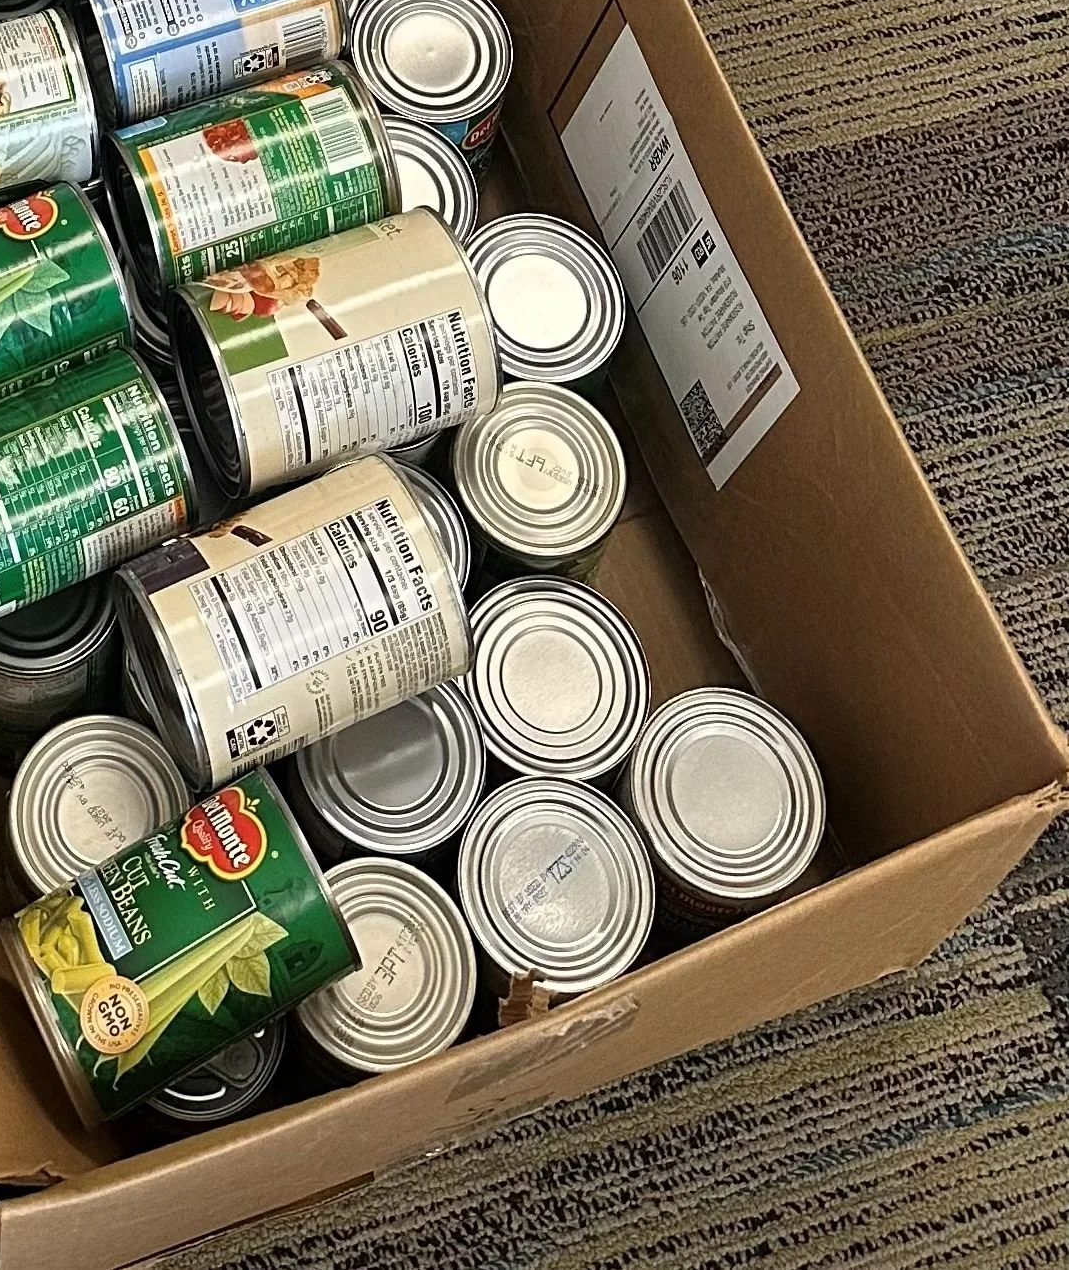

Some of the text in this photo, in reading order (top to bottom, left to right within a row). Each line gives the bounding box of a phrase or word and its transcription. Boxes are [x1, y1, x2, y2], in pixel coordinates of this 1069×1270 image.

[401, 327, 423, 378] Calories
[447, 311, 477, 410] Nutrition Facts
[418, 401, 432, 426] 100
[327, 521, 358, 570] Calories
[374, 498, 433, 612] Nutrition Facts
[369, 609, 390, 634] 90
[210, 812, 252, 869] Monte
[121, 855, 150, 897] CUT
[186, 864, 216, 912] WITH
[98, 905, 128, 956] SODIUM
[115, 880, 155, 946] BEANS
[97, 1000, 120, 1039] GMO
[108, 992, 132, 1034] NON
